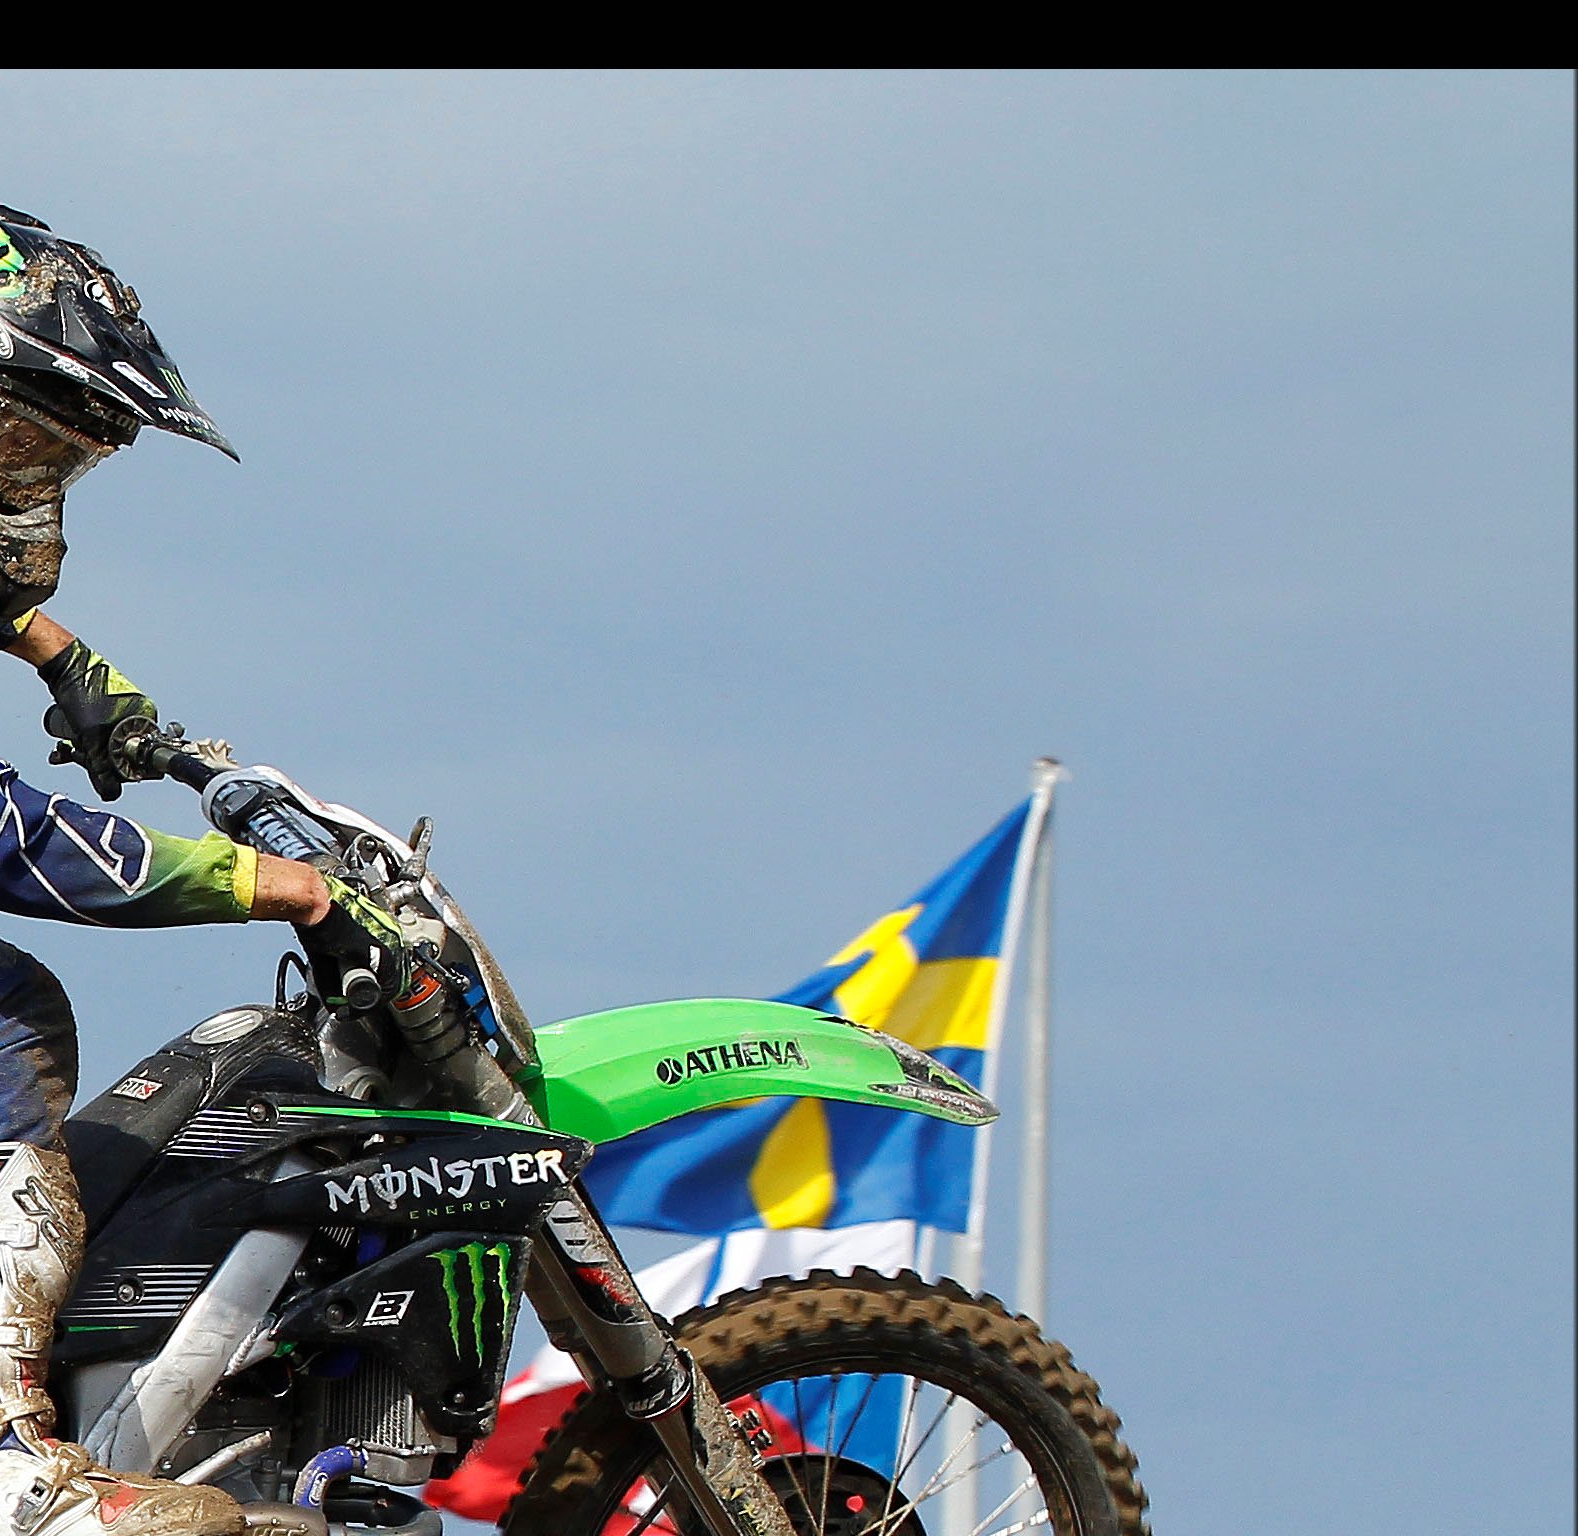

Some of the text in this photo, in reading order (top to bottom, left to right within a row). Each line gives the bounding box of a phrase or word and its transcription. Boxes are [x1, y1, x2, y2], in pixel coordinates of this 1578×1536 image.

[686, 1038, 808, 1080] ATHENA
[324, 1149, 569, 1213] MONSTER
[409, 1198, 507, 1219] ENERGY
